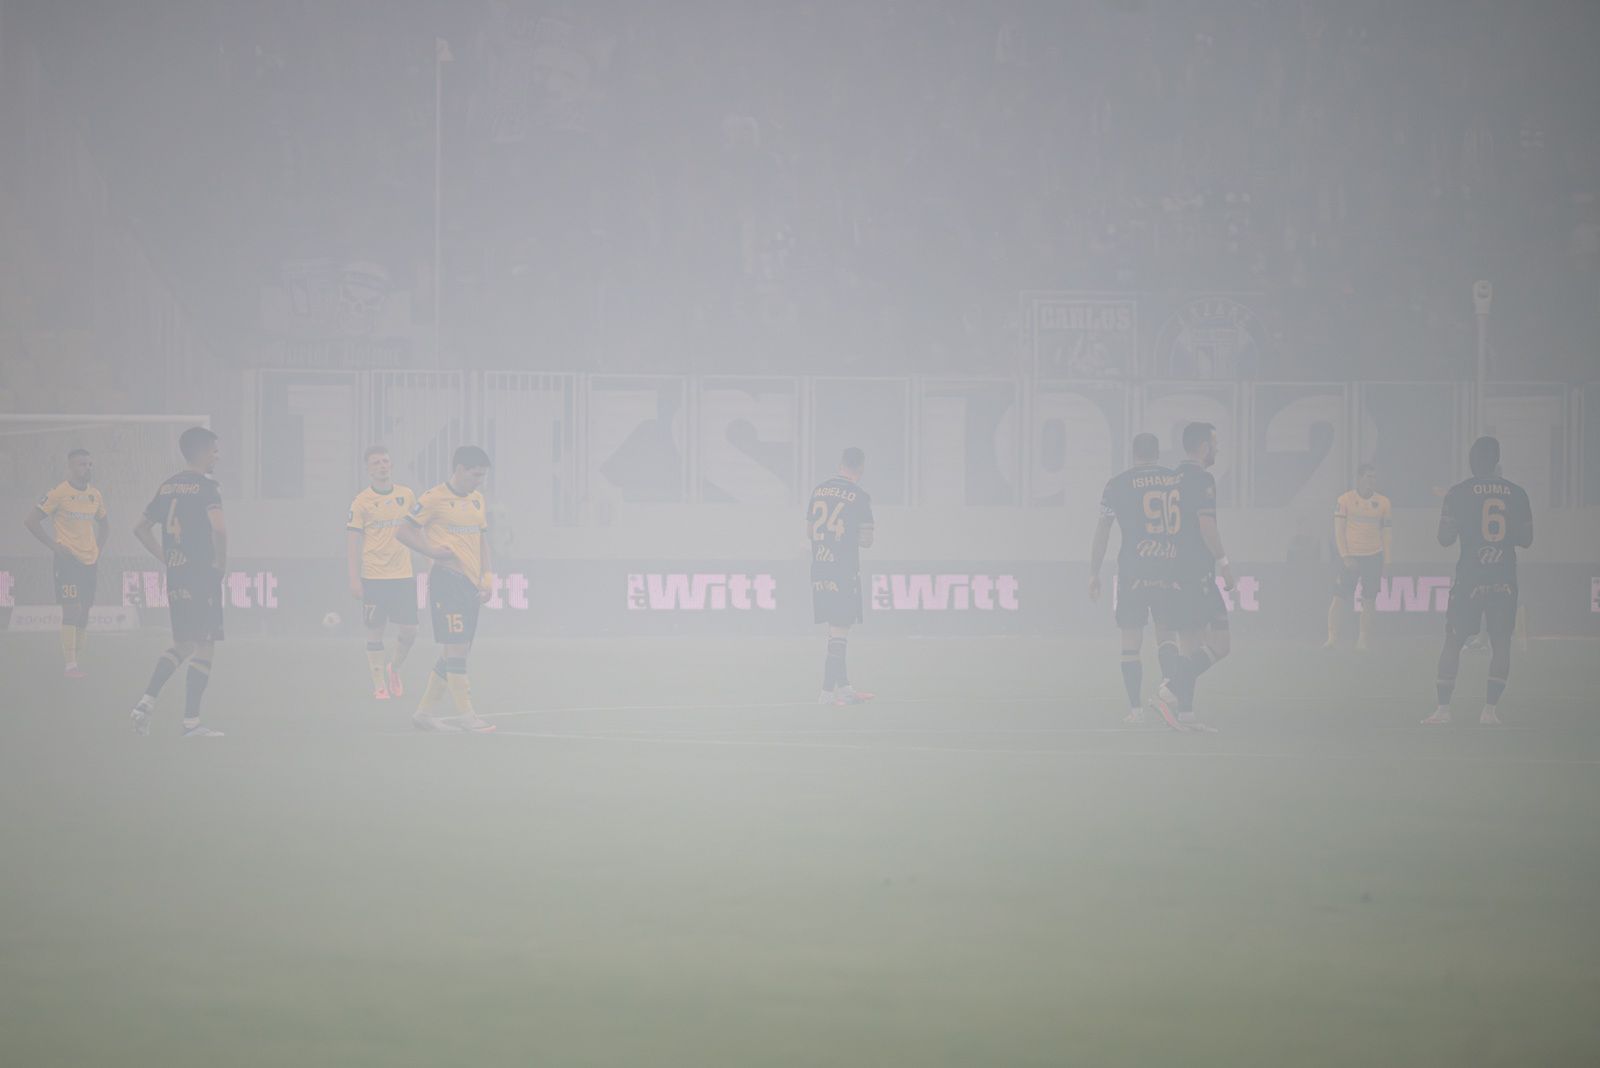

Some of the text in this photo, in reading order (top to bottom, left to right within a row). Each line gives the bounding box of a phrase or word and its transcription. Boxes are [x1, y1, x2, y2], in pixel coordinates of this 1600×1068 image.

[1473, 484, 1511, 496] OUMA
[167, 498, 181, 544] 4
[812, 500, 846, 542] 24
[1481, 498, 1506, 543] 6
[647, 574, 776, 610] Witt
[891, 575, 1018, 610] Witt
[446, 614, 464, 632] 15
